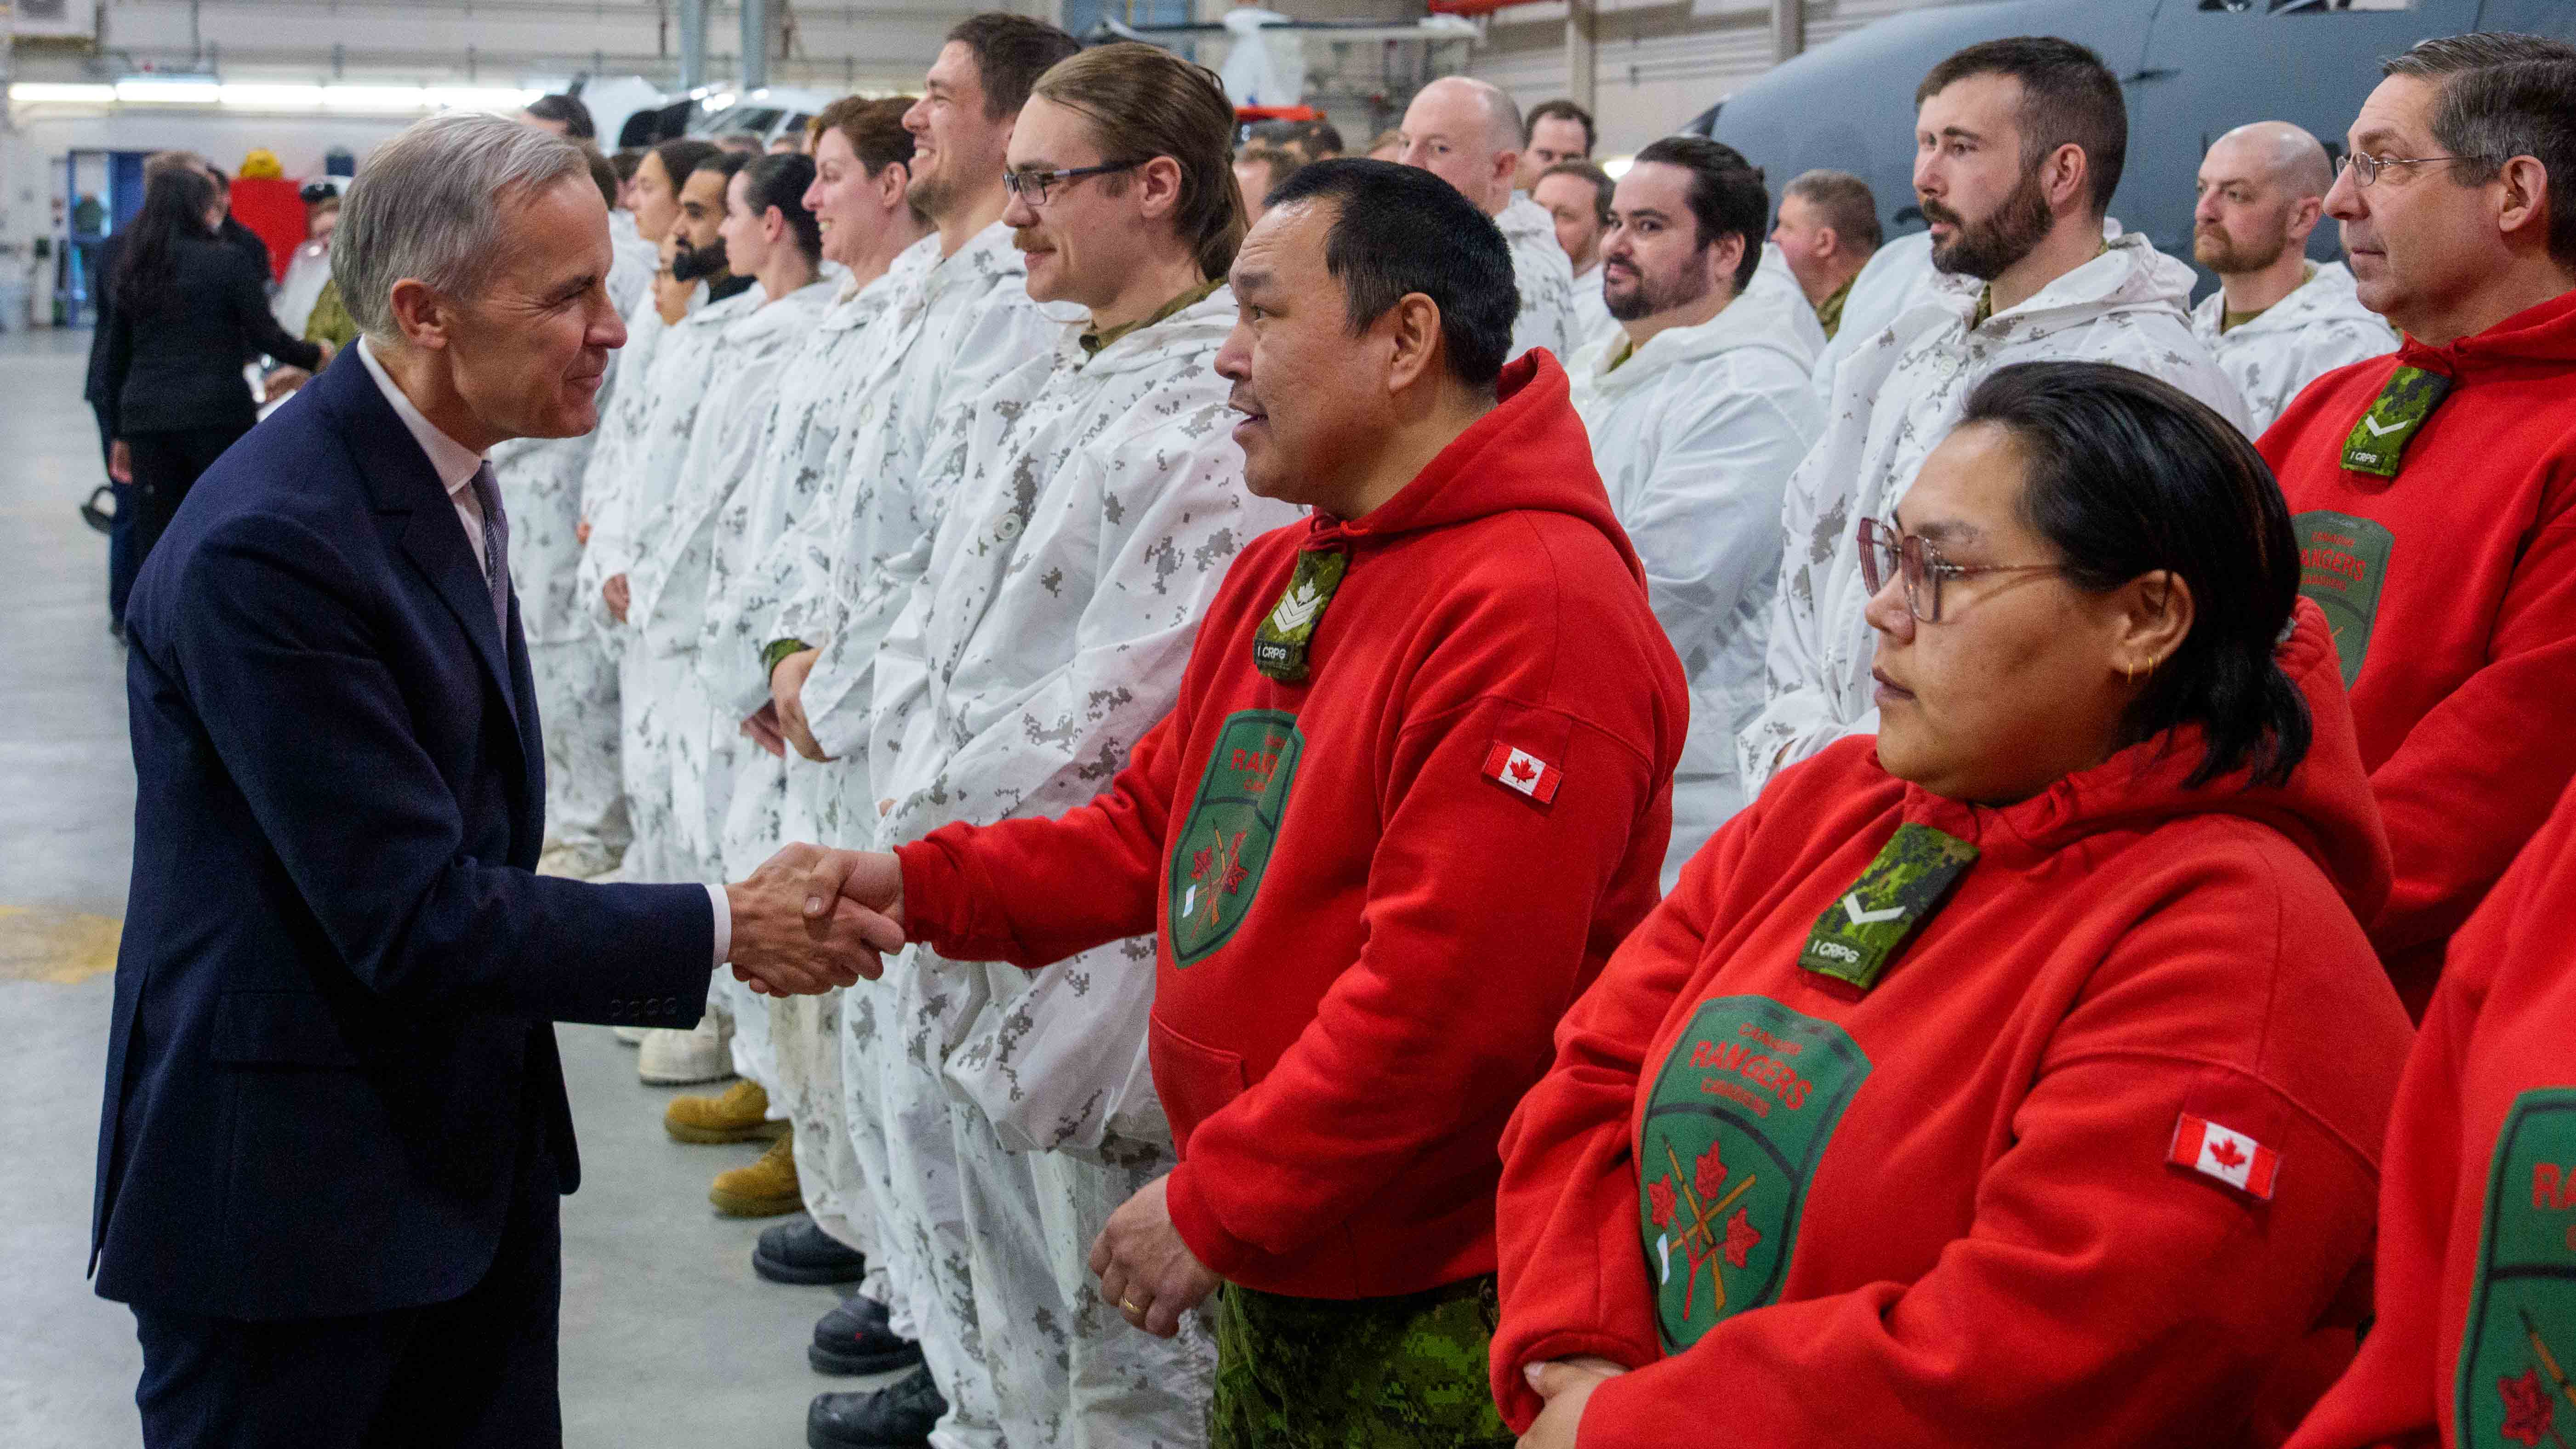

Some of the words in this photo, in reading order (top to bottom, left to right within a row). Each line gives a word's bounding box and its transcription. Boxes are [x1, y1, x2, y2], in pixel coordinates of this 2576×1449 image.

[2355, 452, 2377, 463] CRPG
[2300, 547, 2366, 581] ANGERS
[1262, 646, 1287, 660] CRPG
[1819, 941, 1860, 963] CRPG
[1688, 1040, 1813, 1111] RANGERS
